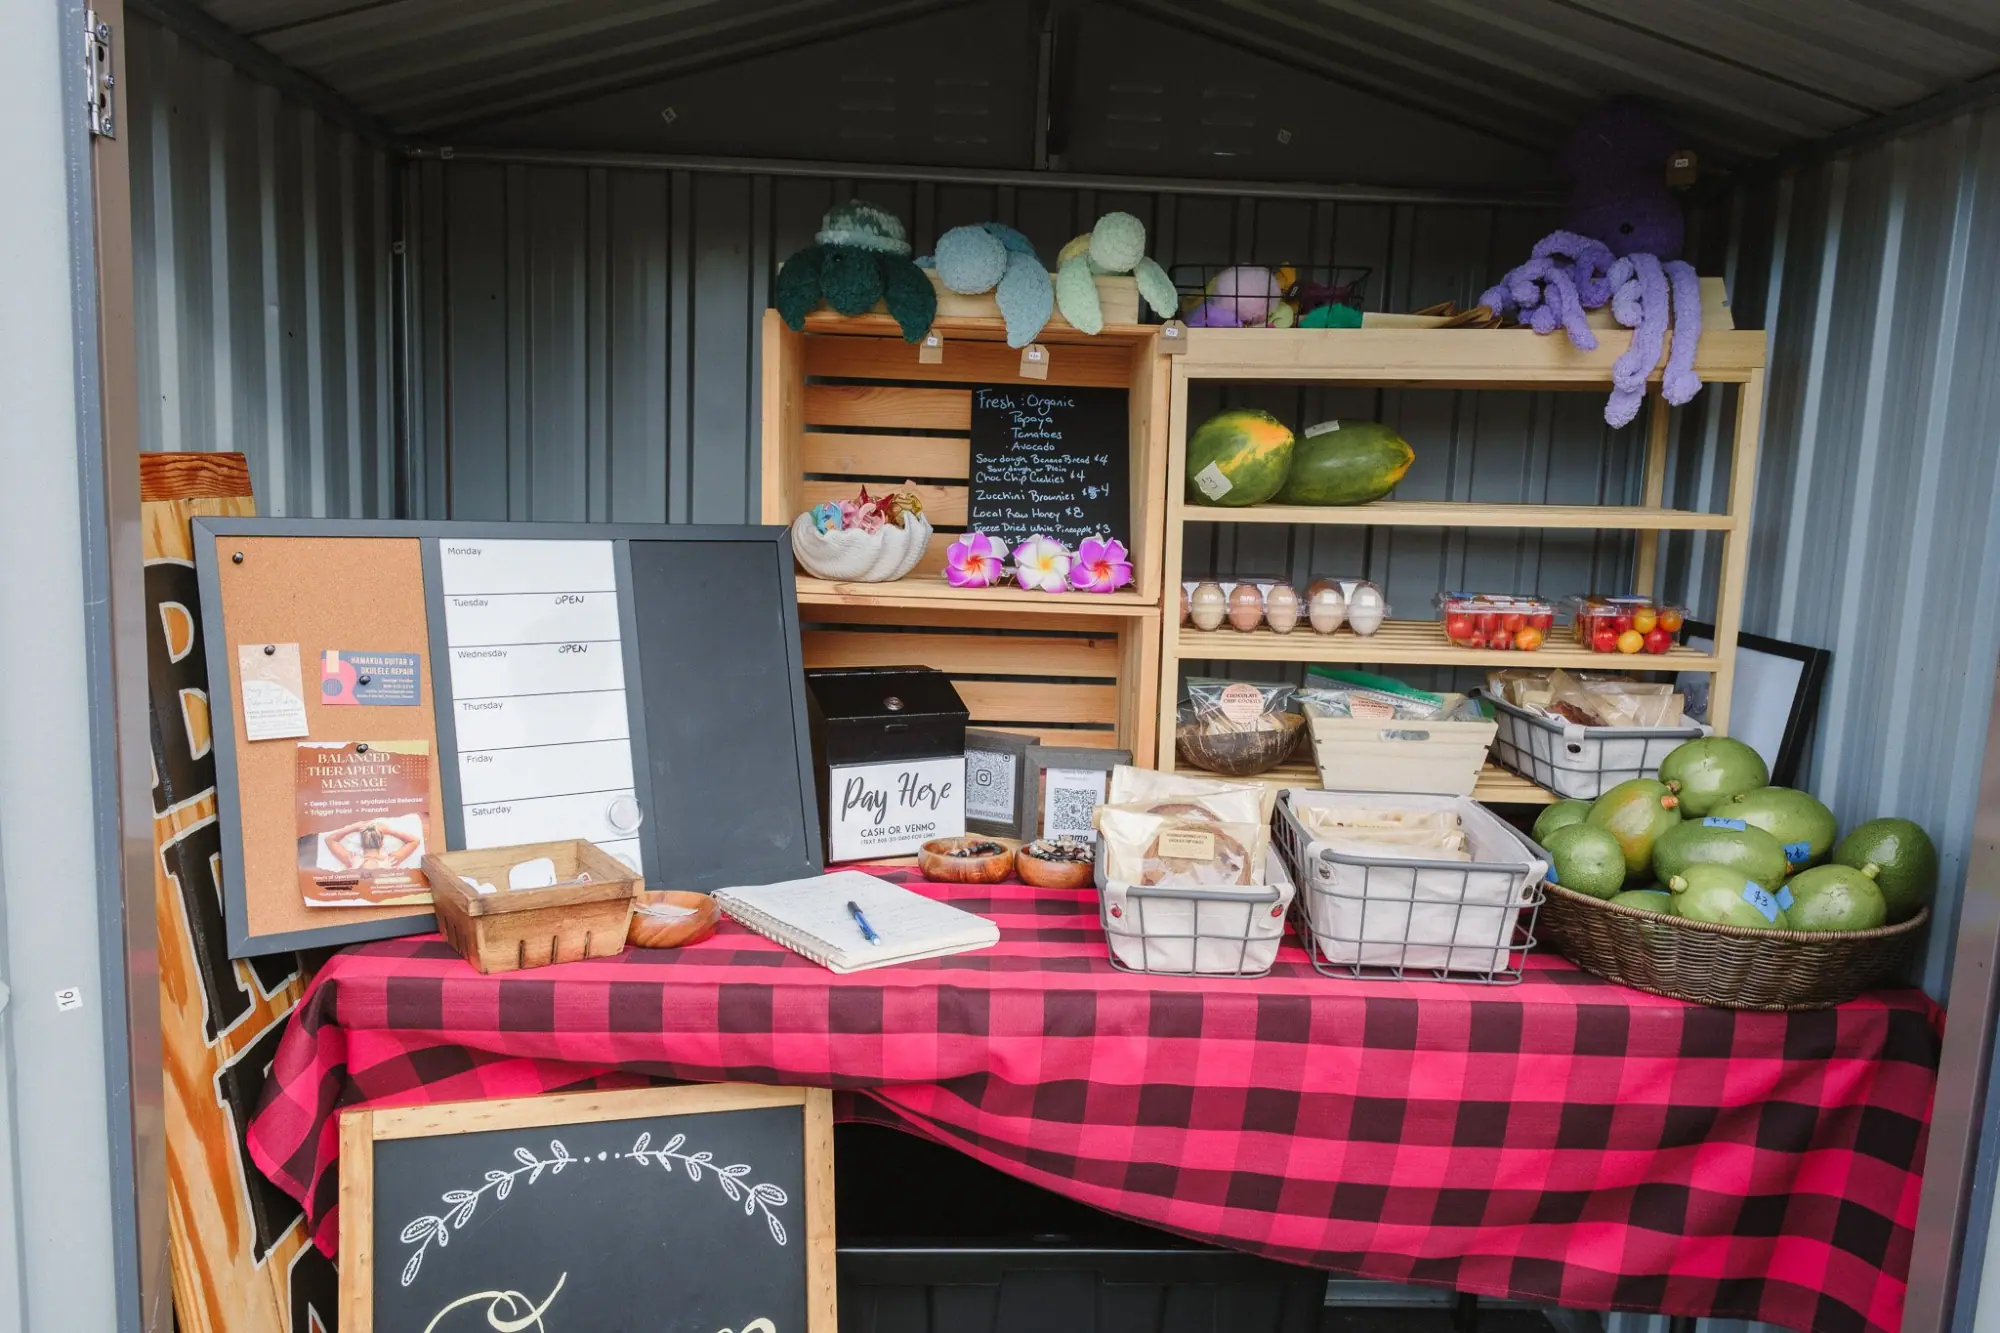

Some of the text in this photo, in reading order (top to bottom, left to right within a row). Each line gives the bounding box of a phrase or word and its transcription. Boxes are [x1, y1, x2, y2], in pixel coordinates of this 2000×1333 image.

[976, 389, 1015, 409] Fresh
[1027, 394, 1075, 415] Organic
[1009, 411, 1053, 429] Papaya
[1011, 428, 1062, 439] Tomatoes
[1011, 441, 1055, 451] Avocado
[1004, 471, 1027, 485] Chip
[976, 489, 1025, 501] Zucchini
[1028, 489, 1075, 502] Brownies
[973, 506, 1002, 518] Local
[1005, 507, 1028, 518] Raw
[1031, 508, 1060, 522] Honey
[972, 522, 1000, 532] Freeze
[1001, 522, 1026, 532] Dried
[1055, 524, 1092, 536] Pineapple
[448, 547, 482, 556] Monday
[453, 598, 489, 607] Tuesday
[555, 595, 584, 605] OPEN
[458, 649, 508, 659] Wednesday
[558, 644, 588, 654] OPEN
[463, 701, 503, 711] Thursday
[318, 752, 390, 764] BALANCED
[467, 754, 493, 764] Friday
[307, 764, 401, 777] THERAPEUTIC
[322, 777, 387, 789] MASSAGE
[329, 799, 350, 807] Tissue
[360, 796, 423, 807] Myofascial Release
[841, 772, 952, 825] Pay Here
[335, 807, 352, 815] Point
[472, 805, 512, 816] Saturday
[860, 821, 936, 838] CASH OR VENMO
[1753, 890, 1768, 907] $3
